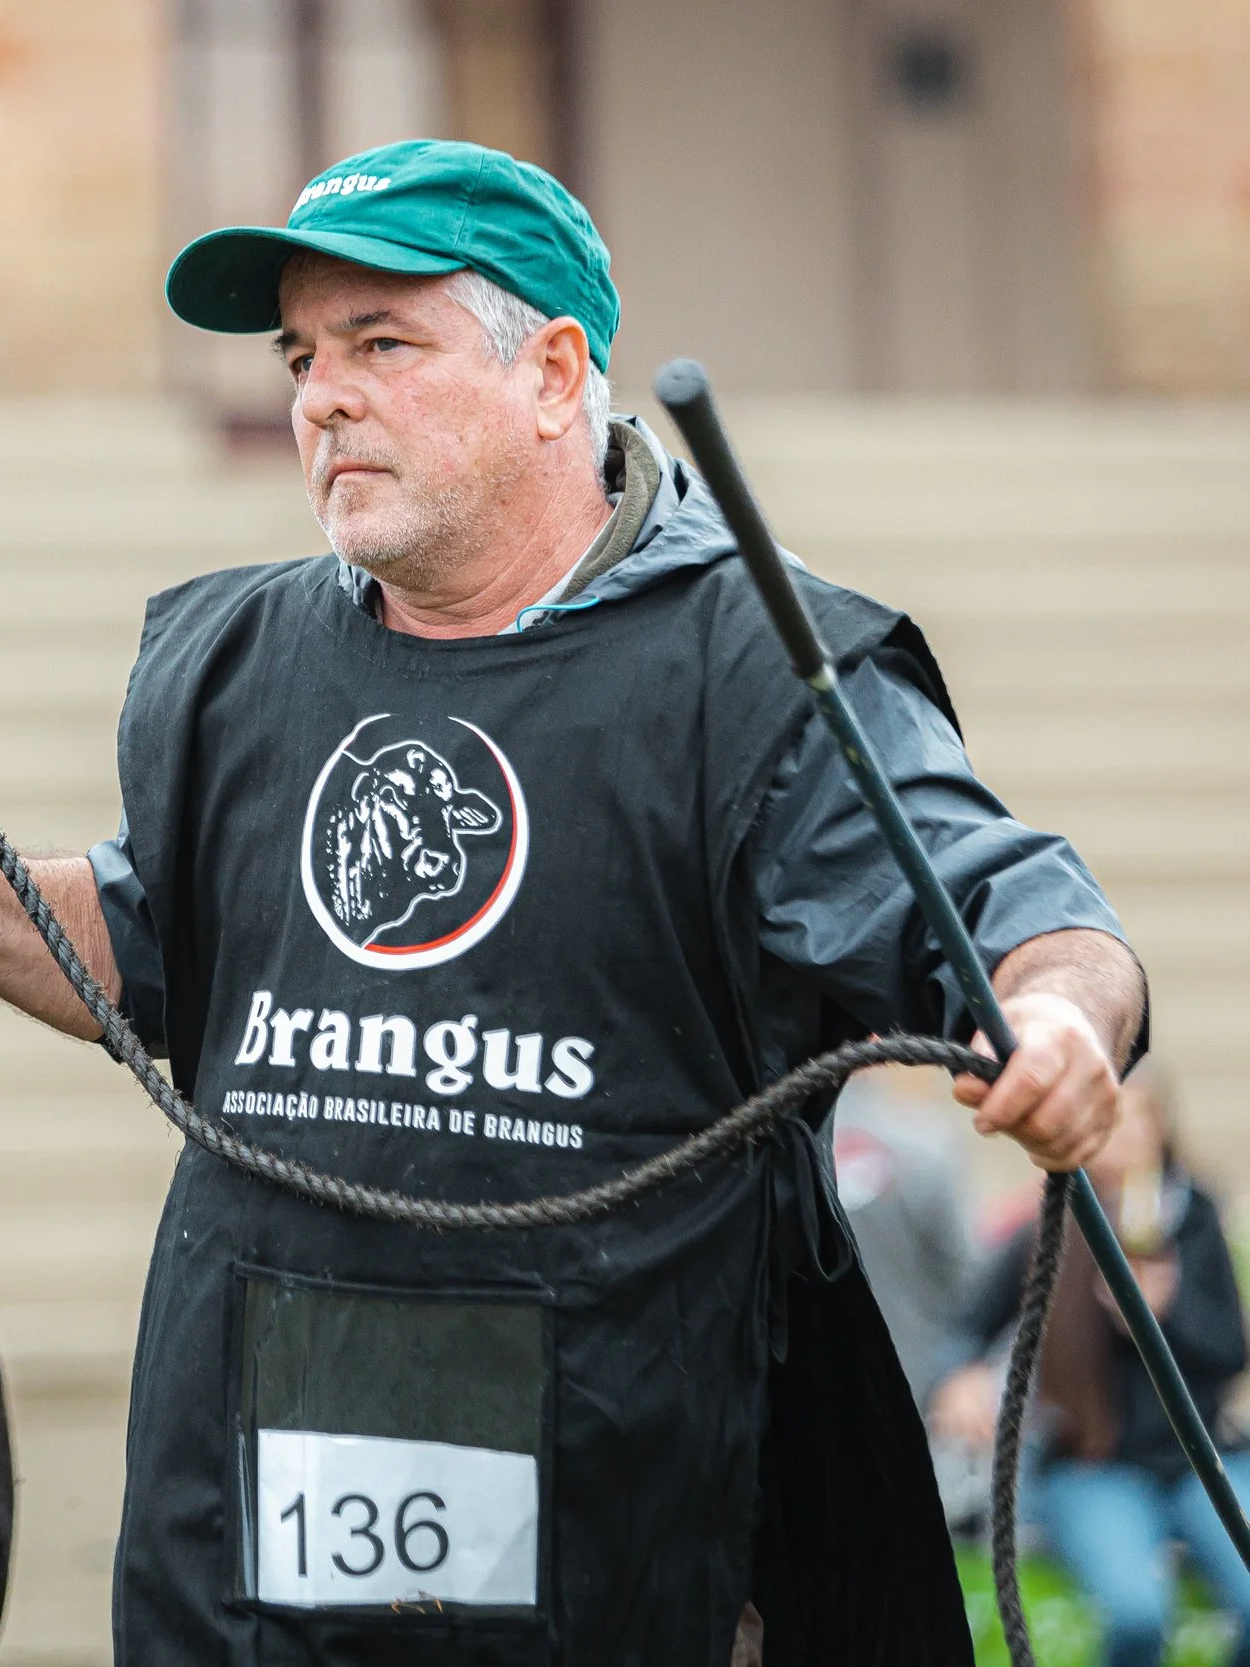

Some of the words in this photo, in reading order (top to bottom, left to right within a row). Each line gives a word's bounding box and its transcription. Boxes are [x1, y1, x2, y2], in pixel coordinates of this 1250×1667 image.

[292, 172, 391, 213] rangus
[235, 989, 595, 1099] Brangus
[222, 1090, 319, 1121] ASSOCIAÇÃO
[323, 1095, 441, 1131] BRASILEIRA
[448, 1108, 476, 1136] DE
[483, 1113, 584, 1149] BRANGUS
[280, 1489, 449, 1579] 136
